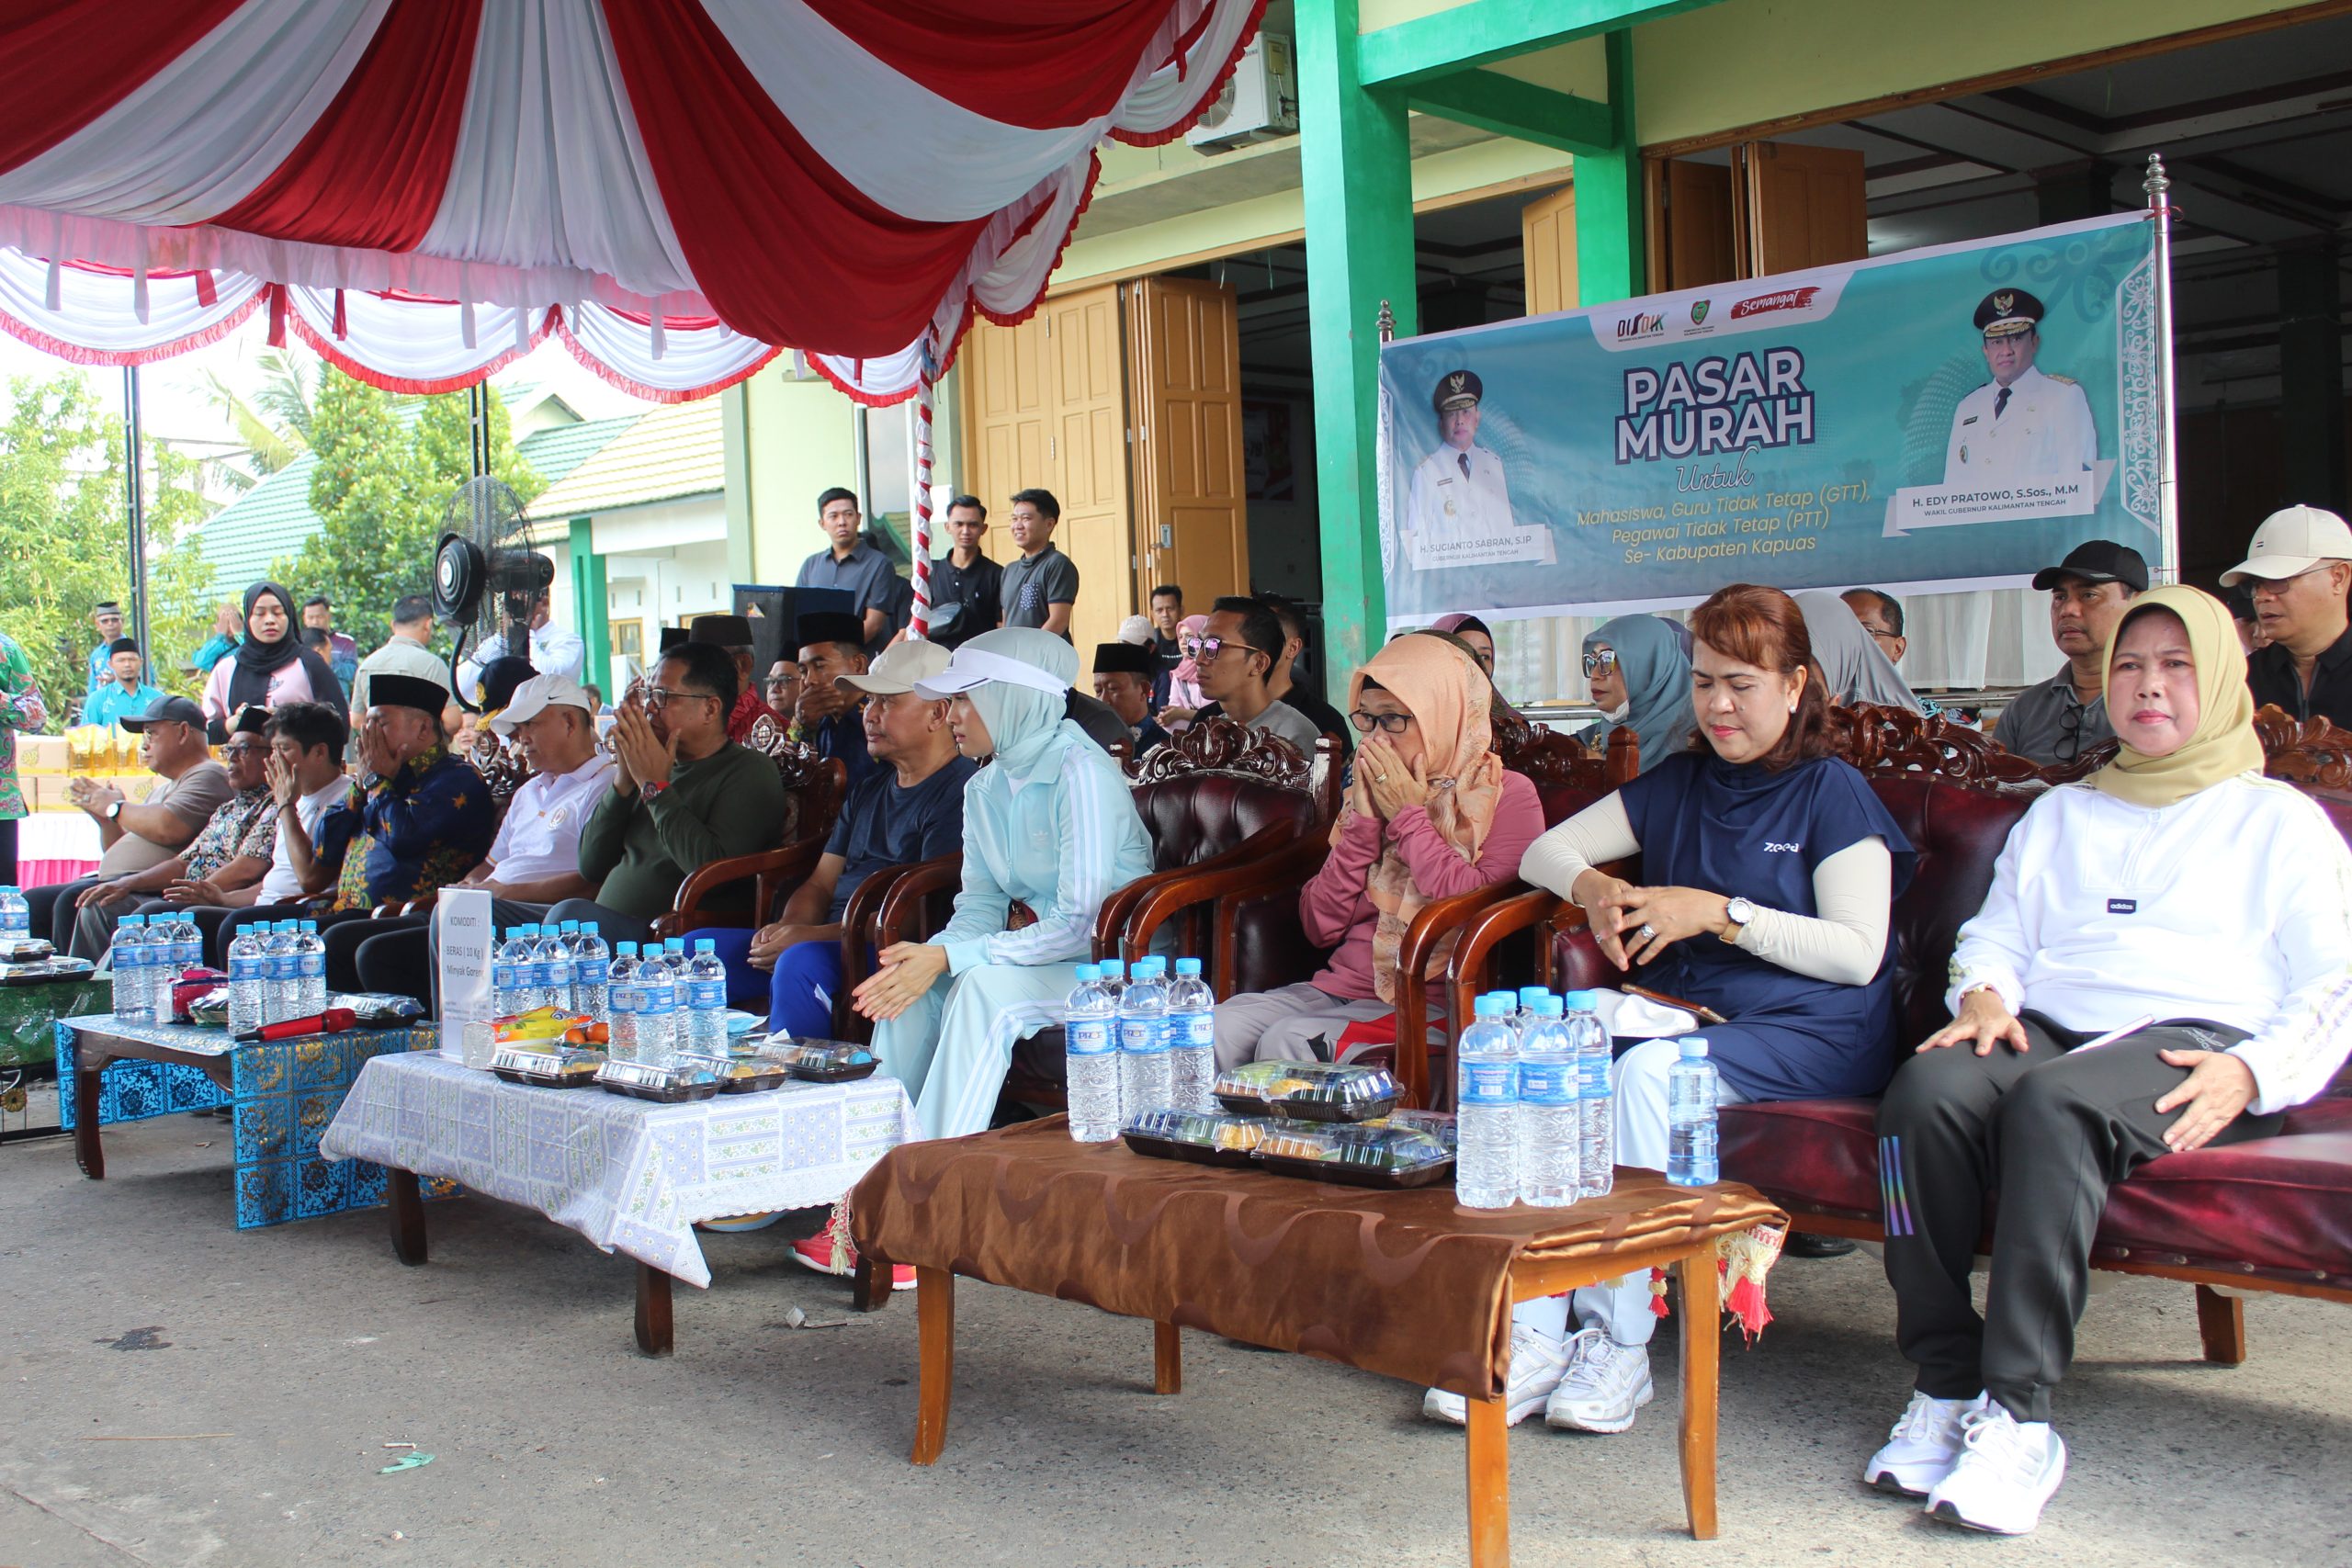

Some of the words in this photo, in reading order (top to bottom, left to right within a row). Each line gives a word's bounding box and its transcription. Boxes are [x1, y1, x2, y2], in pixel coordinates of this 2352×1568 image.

[1741, 290, 1799, 315] Semangat
[1626, 348, 1804, 415] PASAR
[1617, 393, 1813, 462] MURAH
[1675, 445, 1758, 492] Untuk
[1577, 505, 1666, 525] Mahasiswa,
[1672, 502, 1710, 517] Guru
[1716, 496, 1758, 513] Tidak
[1766, 491, 1814, 510] Tetap
[1820, 479, 1871, 504] (GTT),
[1912, 498, 1924, 507] H.
[1926, 496, 1949, 506] EDY
[1951, 491, 2014, 504] PRATOWO,
[2016, 488, 2052, 499] S.Sos.,
[2054, 484, 2079, 494] M.M
[1924, 508, 1947, 516] WAKIL
[1948, 505, 1987, 514] GUBERNUR
[1988, 502, 2036, 511] KALIMANTAN
[2036, 499, 2066, 507] TENGAH
[1612, 524, 1679, 547] Pegawai
[1686, 518, 1727, 537] Tidak
[1734, 514, 1781, 535] Tetap
[1787, 506, 1829, 531] (PTT)
[1419, 545, 1429, 554] H.
[1430, 540, 1474, 552] SUGIANTO
[1475, 537, 1513, 548] SABRAN,
[1515, 536, 1532, 545] S.IP
[1461, 551, 1496, 559] KALIMANTAN
[1624, 550, 1651, 564] Se-
[1657, 539, 1746, 561] Kabupaten
[1752, 536, 1815, 557] Kapuas
[450, 917, 476, 927] KOMODITI
[446, 945, 463, 956] BERAS
[447, 964, 466, 976] Minyak
